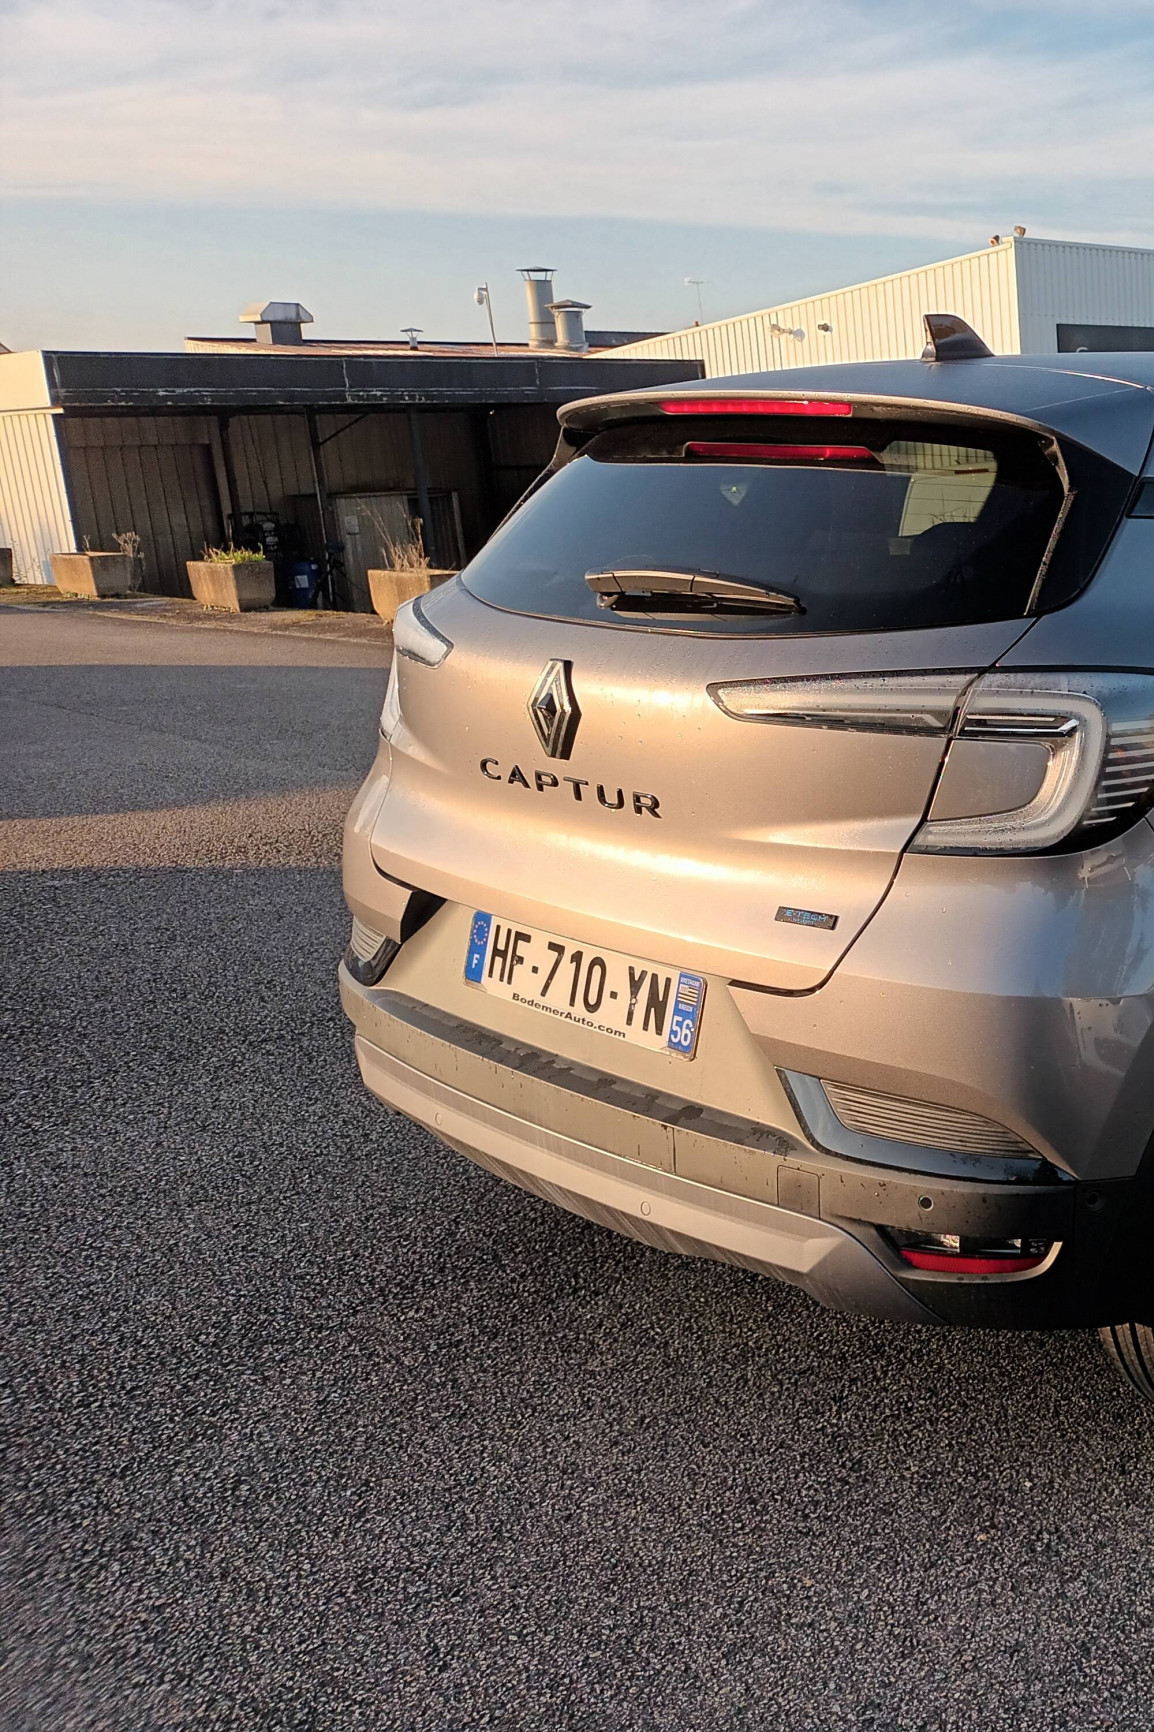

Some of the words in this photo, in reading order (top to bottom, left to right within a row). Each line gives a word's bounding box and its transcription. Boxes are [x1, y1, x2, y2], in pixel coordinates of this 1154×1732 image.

[479, 757, 663, 819] CAPTUR
[471, 953, 480, 969] F
[487, 924, 672, 1037] HF-710-YN
[511, 992, 626, 1038] BodemerAuto.com
[670, 1015, 694, 1047] 56
